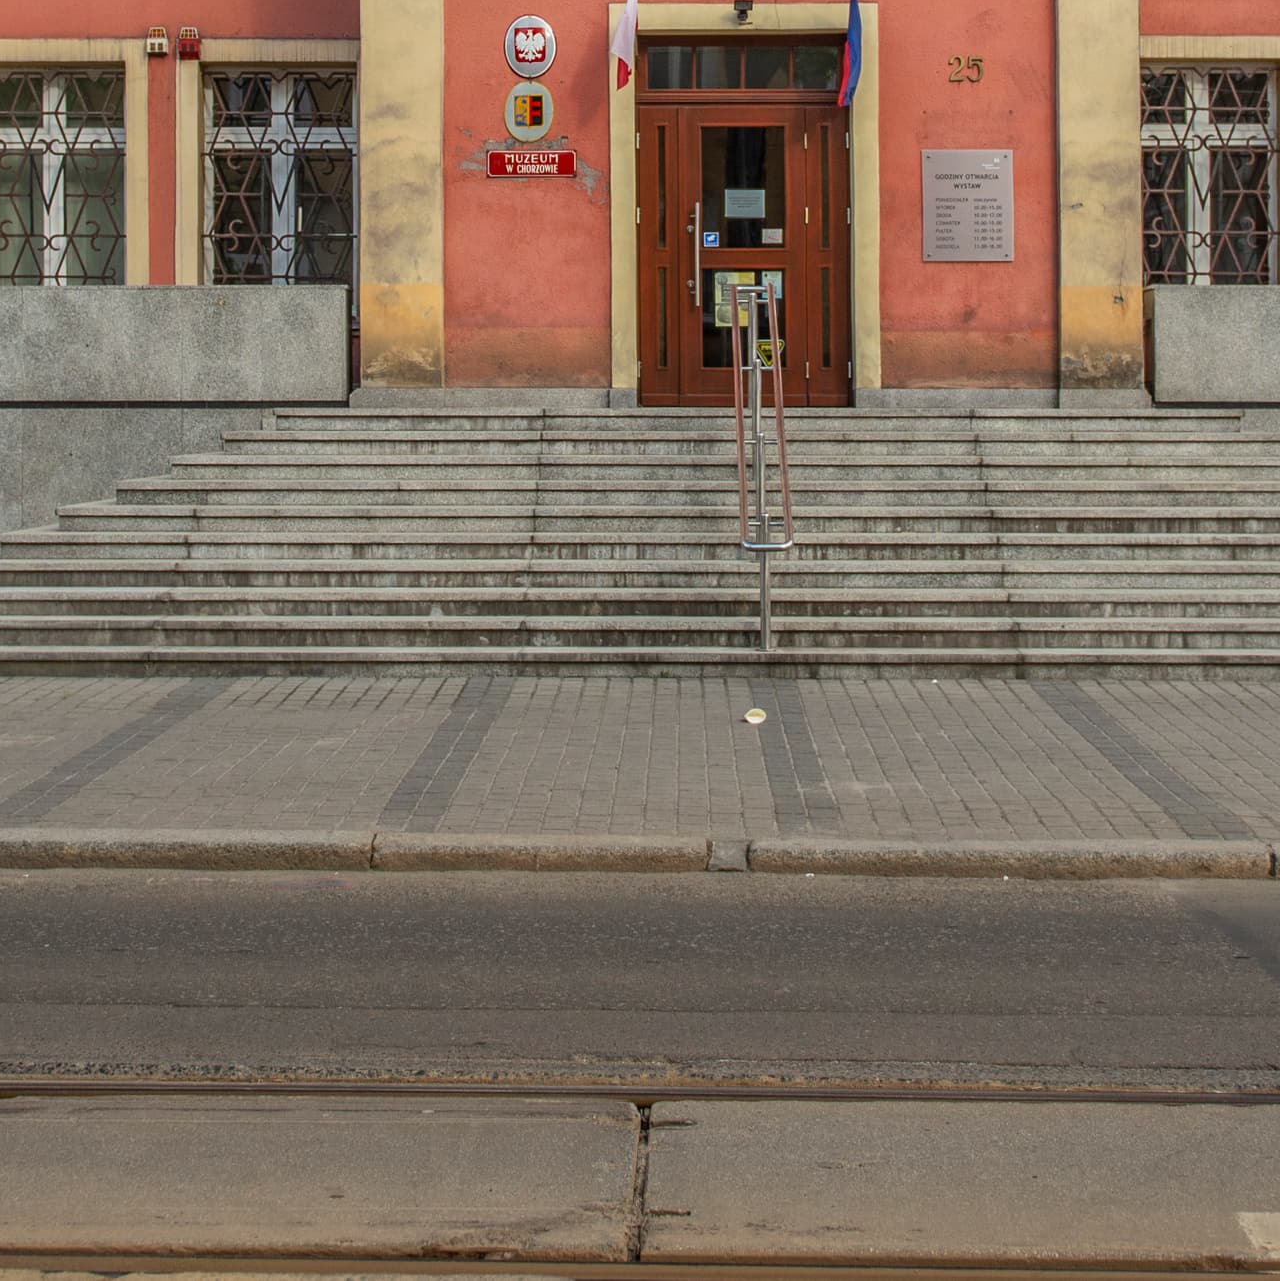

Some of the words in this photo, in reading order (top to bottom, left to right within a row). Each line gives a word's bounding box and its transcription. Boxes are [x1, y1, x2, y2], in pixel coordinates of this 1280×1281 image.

[948, 55, 984, 83] 25
[504, 153, 559, 164] MUZEUM
[505, 164, 514, 174] W
[516, 164, 559, 174] CHORZOWIE
